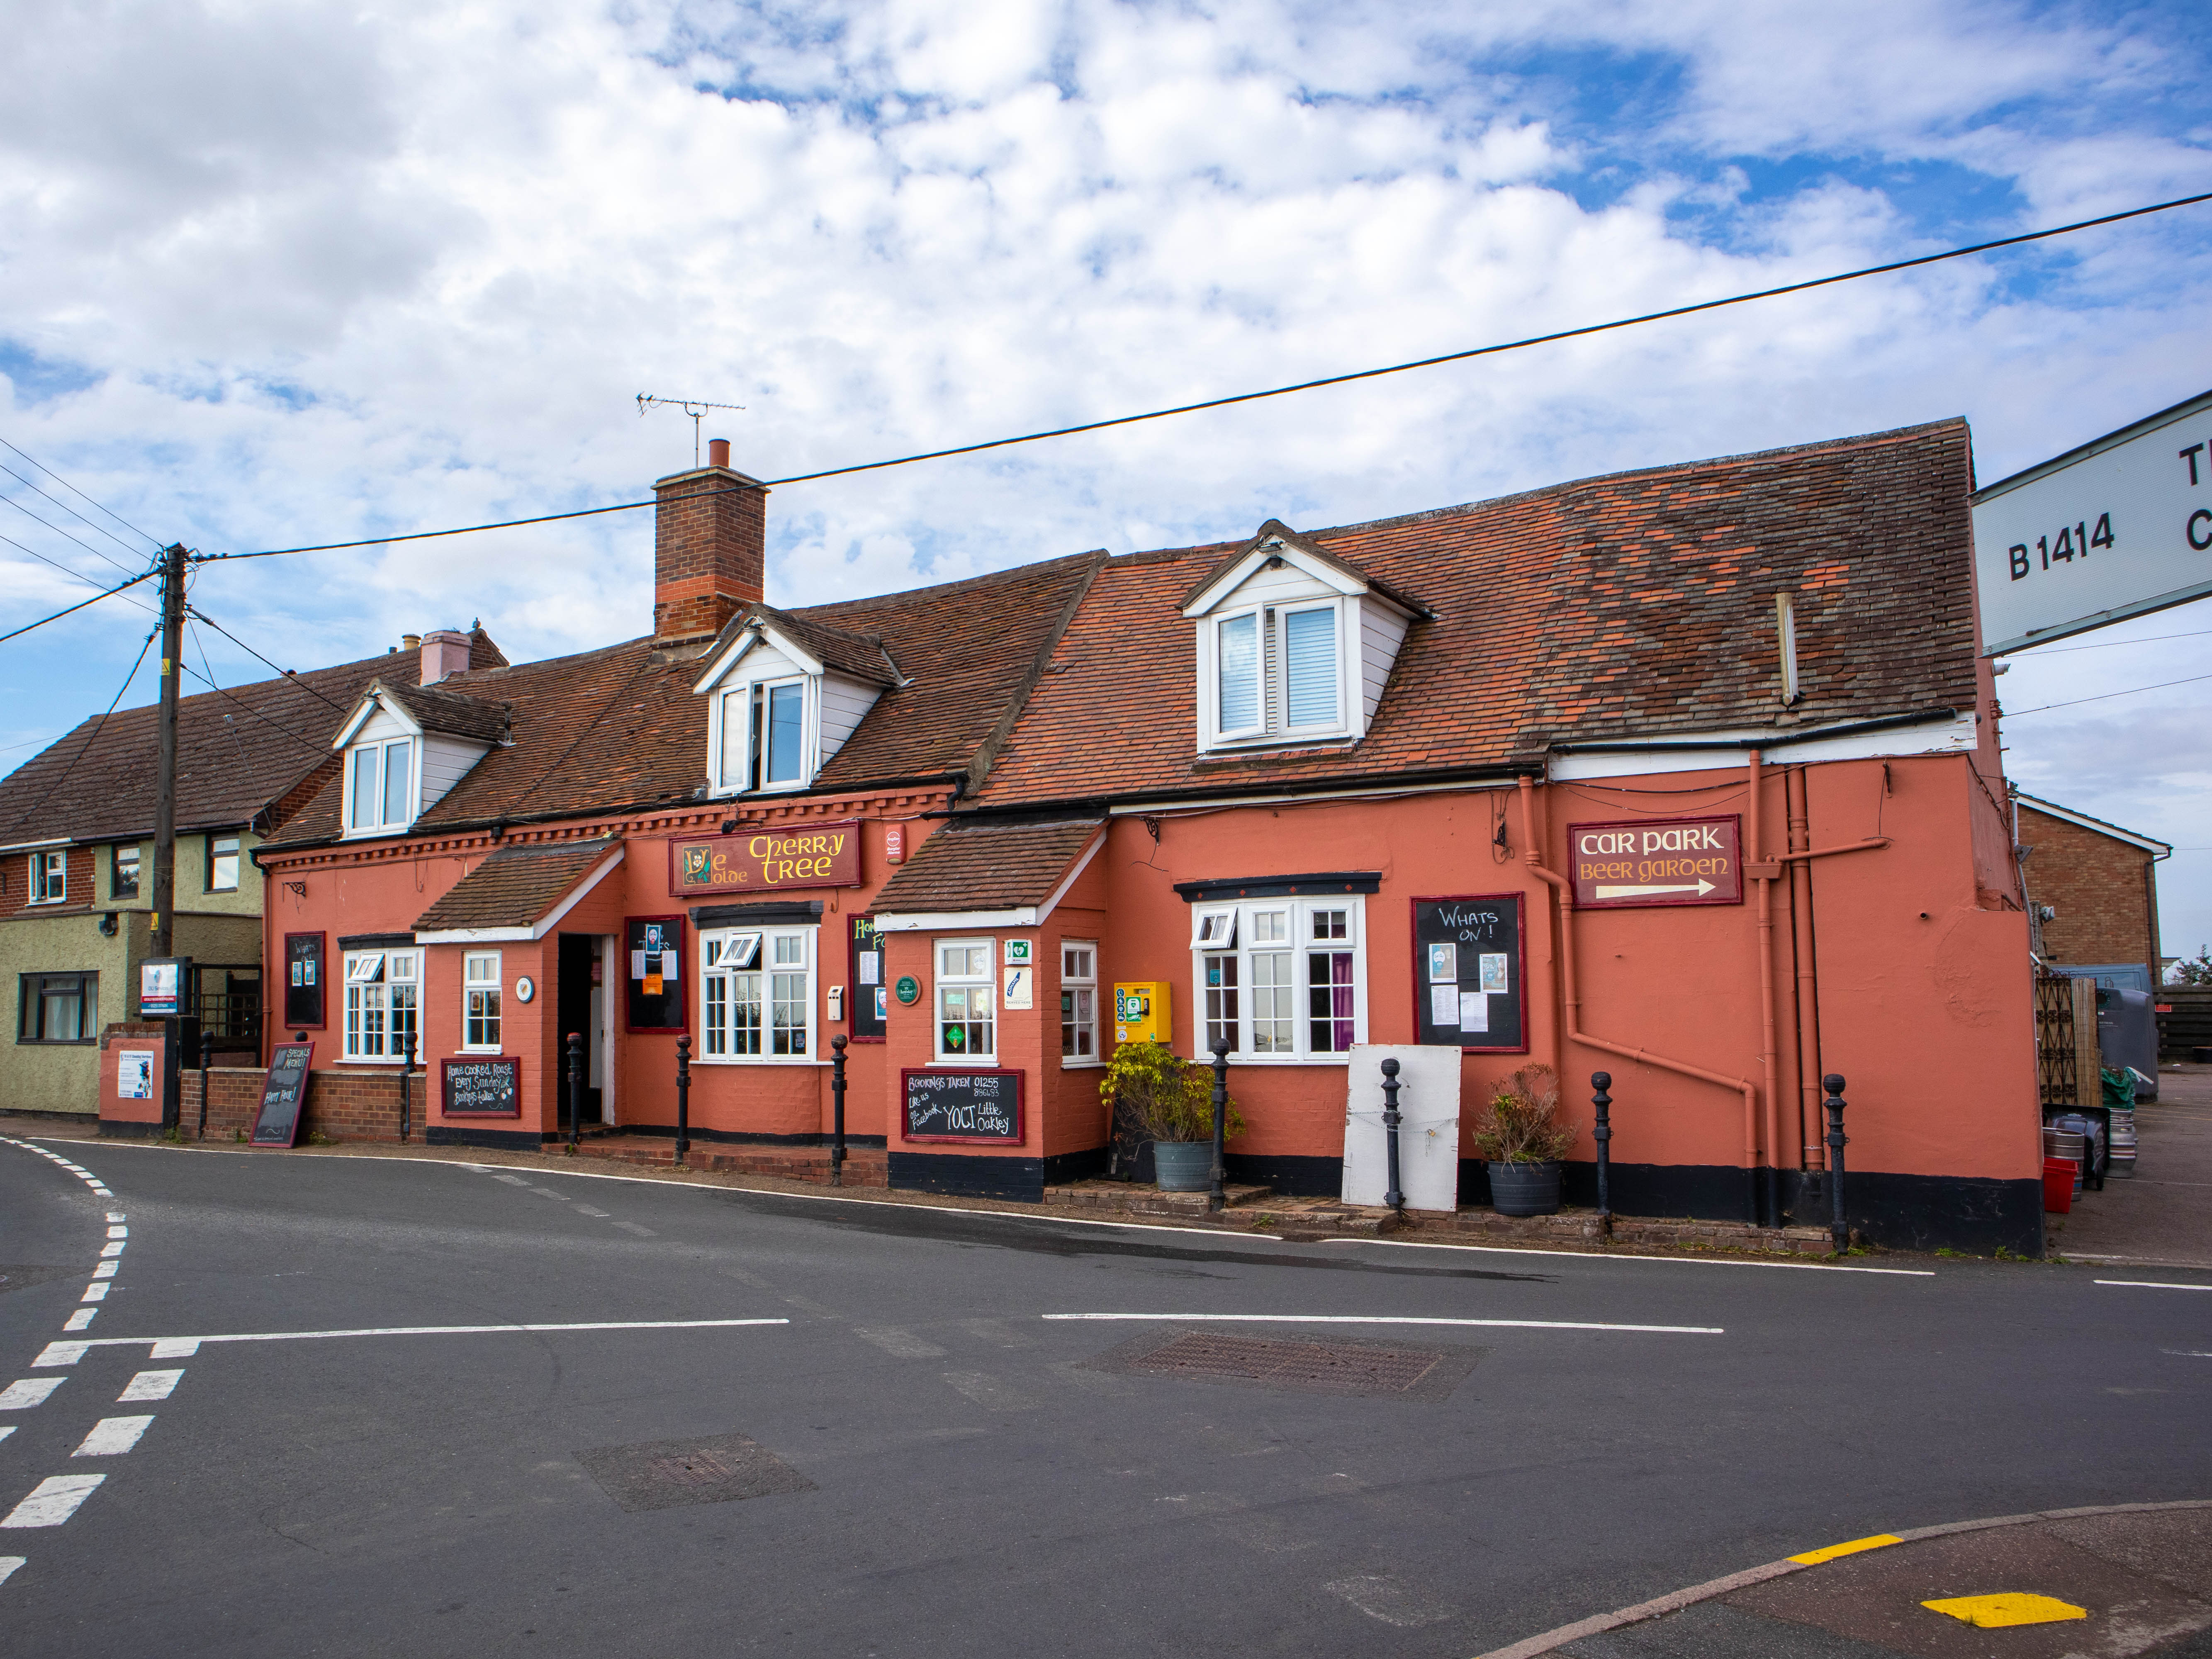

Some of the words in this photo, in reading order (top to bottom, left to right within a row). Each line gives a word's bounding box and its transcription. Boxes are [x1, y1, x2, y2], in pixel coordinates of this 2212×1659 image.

[2009, 512, 2115, 581] B1414
[749, 834, 845, 858] Cherry
[685, 849, 727, 884] Ye
[713, 871, 747, 884] olde
[1438, 905, 1498, 927] WHATS
[1007, 977, 1019, 995] ADNAMS
[287, 1048, 310, 1058] SPECIALS
[447, 1065, 464, 1082] Home
[493, 1063, 512, 1078] Roast
[473, 1076, 501, 1094] Sunday
[908, 1076, 945, 1091] BOOKINGS
[947, 1076, 970, 1089] TAKEN
[974, 1077, 999, 1088] 01255
[974, 1088, 999, 1097] 886483
[921, 1092, 929, 1101] us
[913, 1103, 942, 1130] Facebook
[978, 1102, 1002, 1115] Little
[978, 1117, 1009, 1134] Oakley
